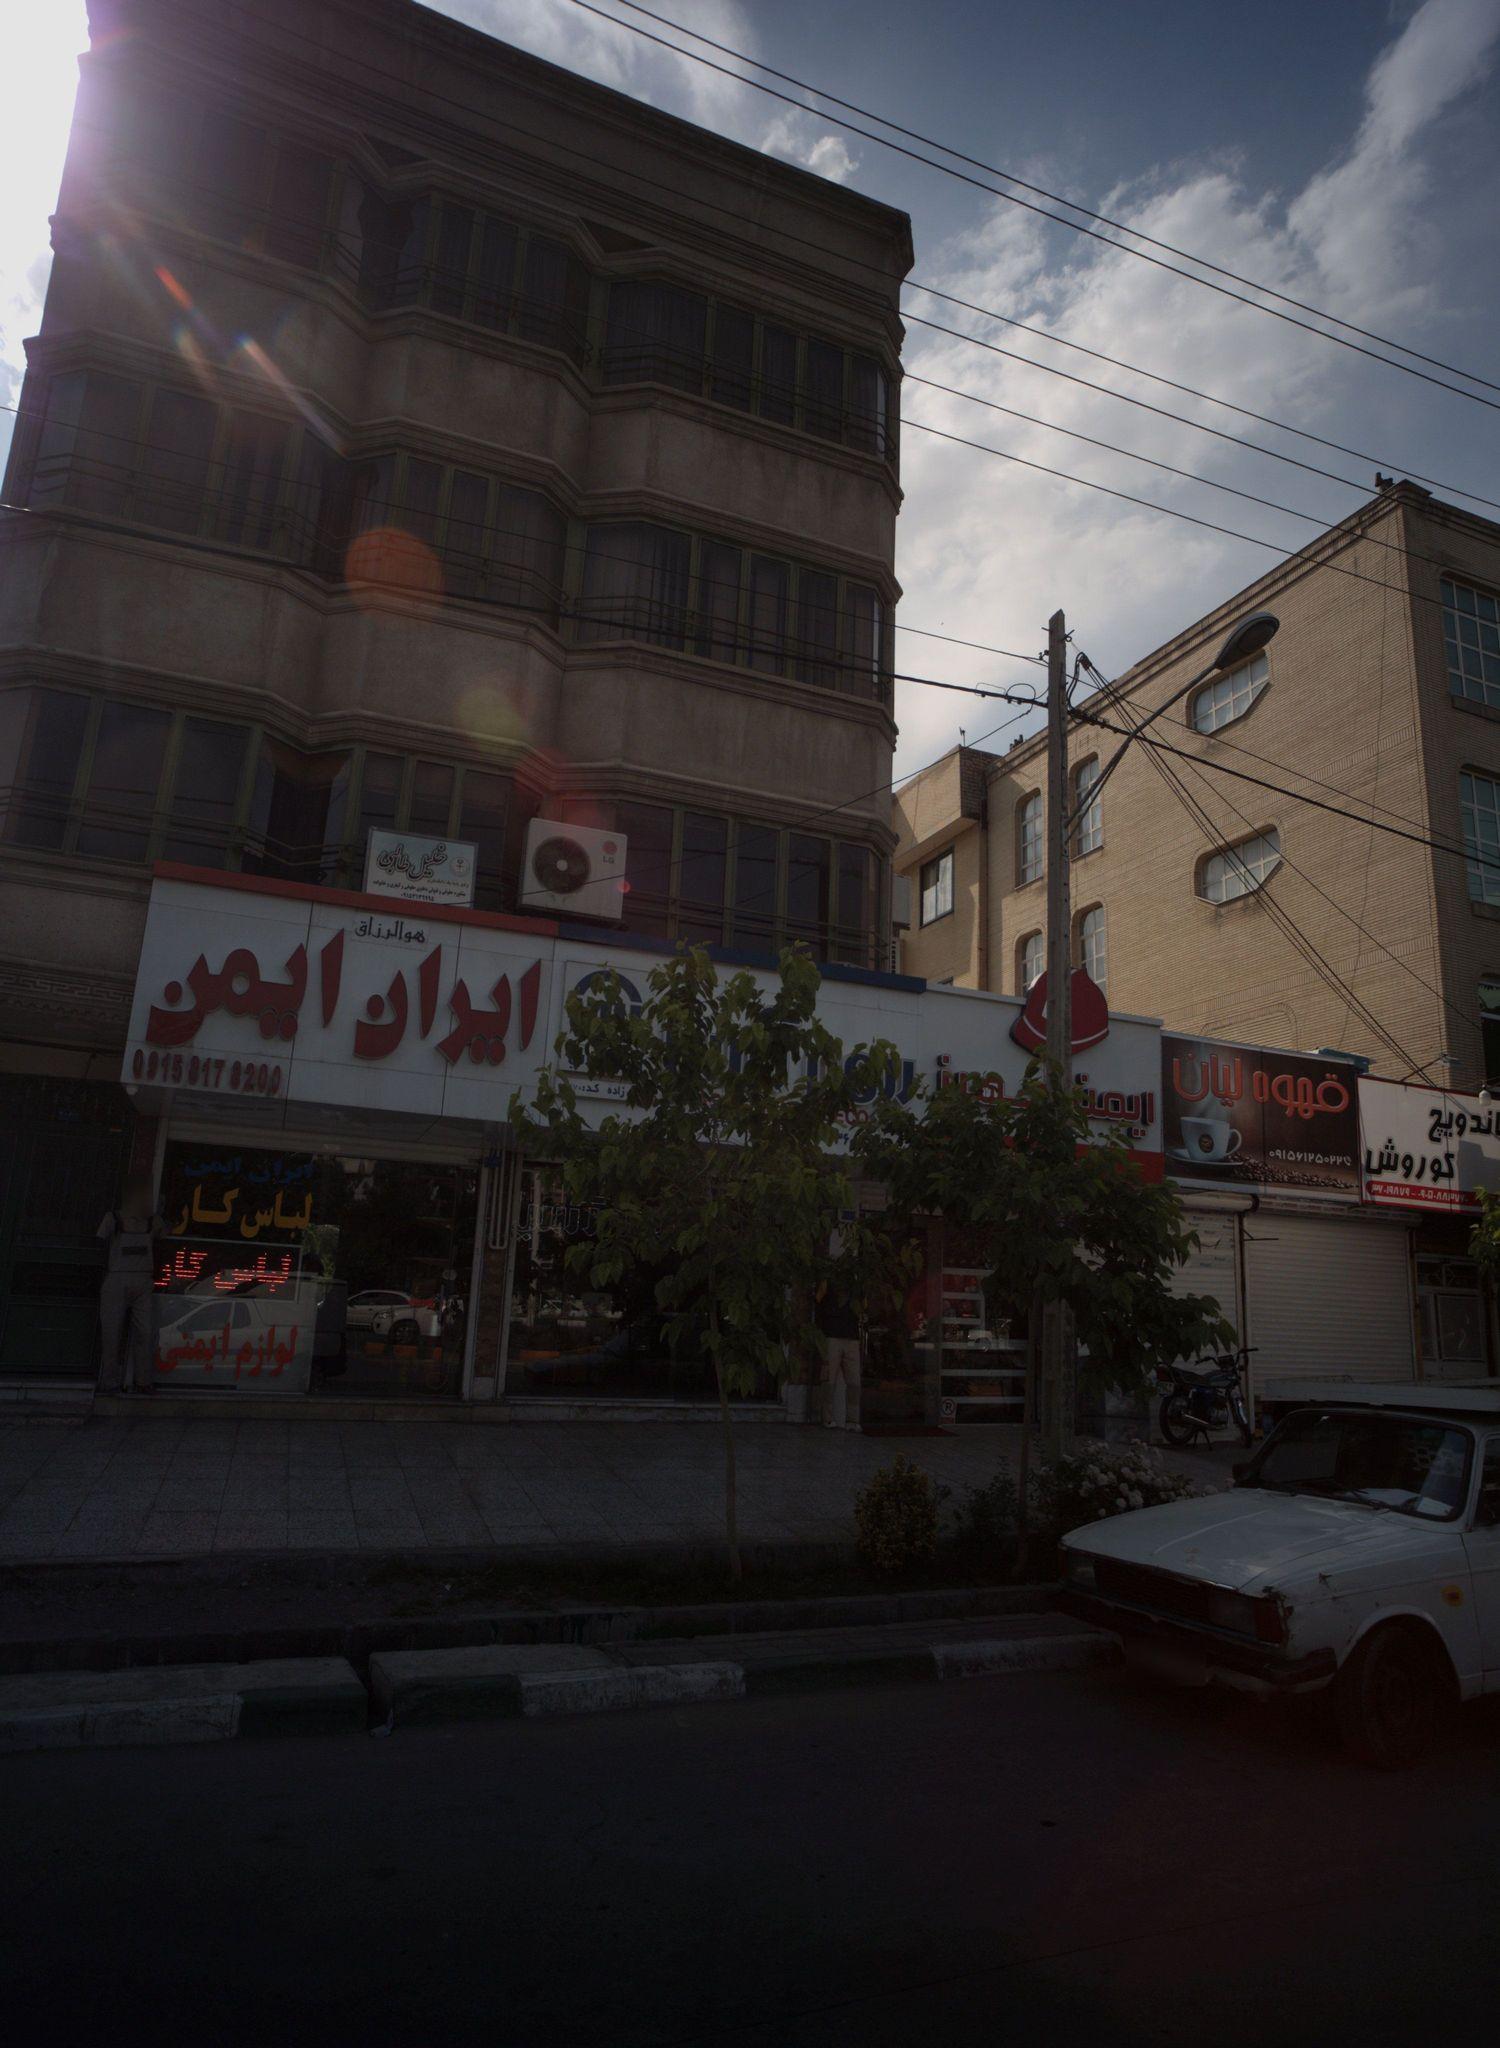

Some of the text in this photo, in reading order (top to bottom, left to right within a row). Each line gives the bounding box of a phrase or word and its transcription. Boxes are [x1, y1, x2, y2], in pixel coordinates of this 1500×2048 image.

[602, 855, 615, 864] LG
[145, 928, 543, 1067] ایران ایمن
[1172, 1052, 1351, 1121] قهوه لیان
[1428, 1109, 1500, 1143] اندویچ
[1365, 1136, 1455, 1184] کوروش
[167, 1183, 313, 1239] لباس کار
[153, 1247, 293, 1293] لباس کار
[154, 1320, 298, 1382] لوازم ایمنی
